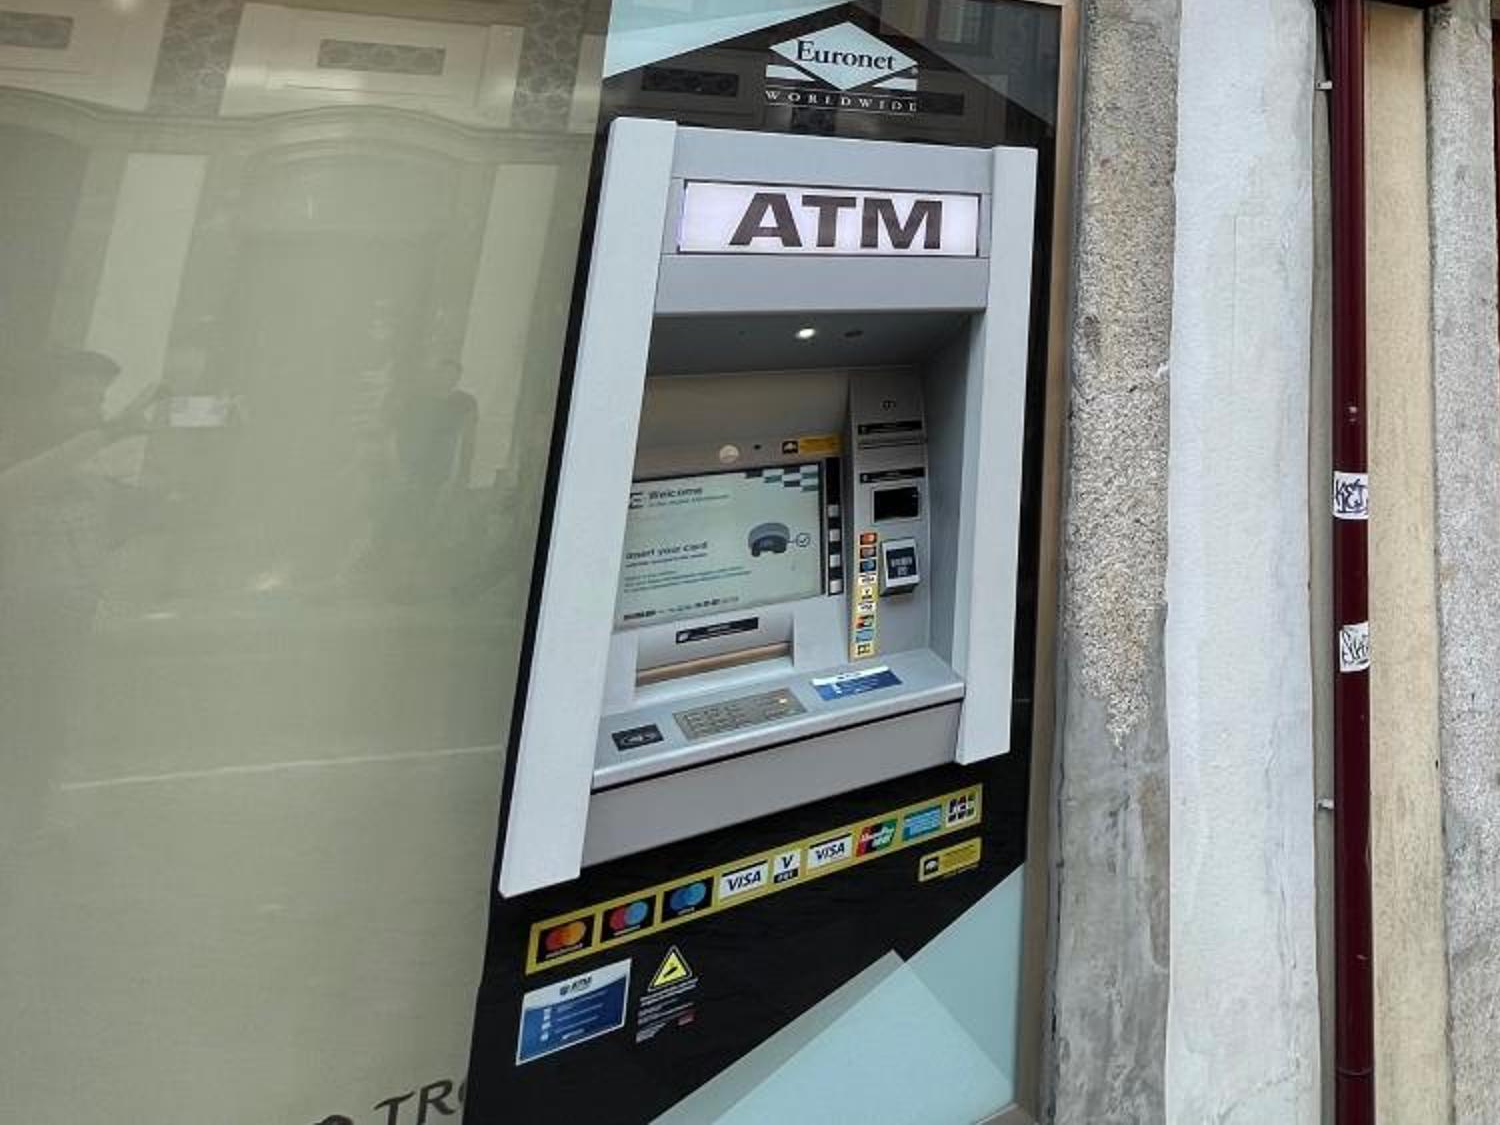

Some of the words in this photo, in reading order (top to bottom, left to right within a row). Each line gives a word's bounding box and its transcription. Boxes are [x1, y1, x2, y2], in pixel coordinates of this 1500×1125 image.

[797, 40, 896, 71] Euronet
[766, 90, 917, 112] WORLDWIDE
[728, 191, 943, 250] ATM
[728, 872, 761, 892] VISA
[815, 842, 846, 861] VISA
[373, 1079, 467, 1125] TR
